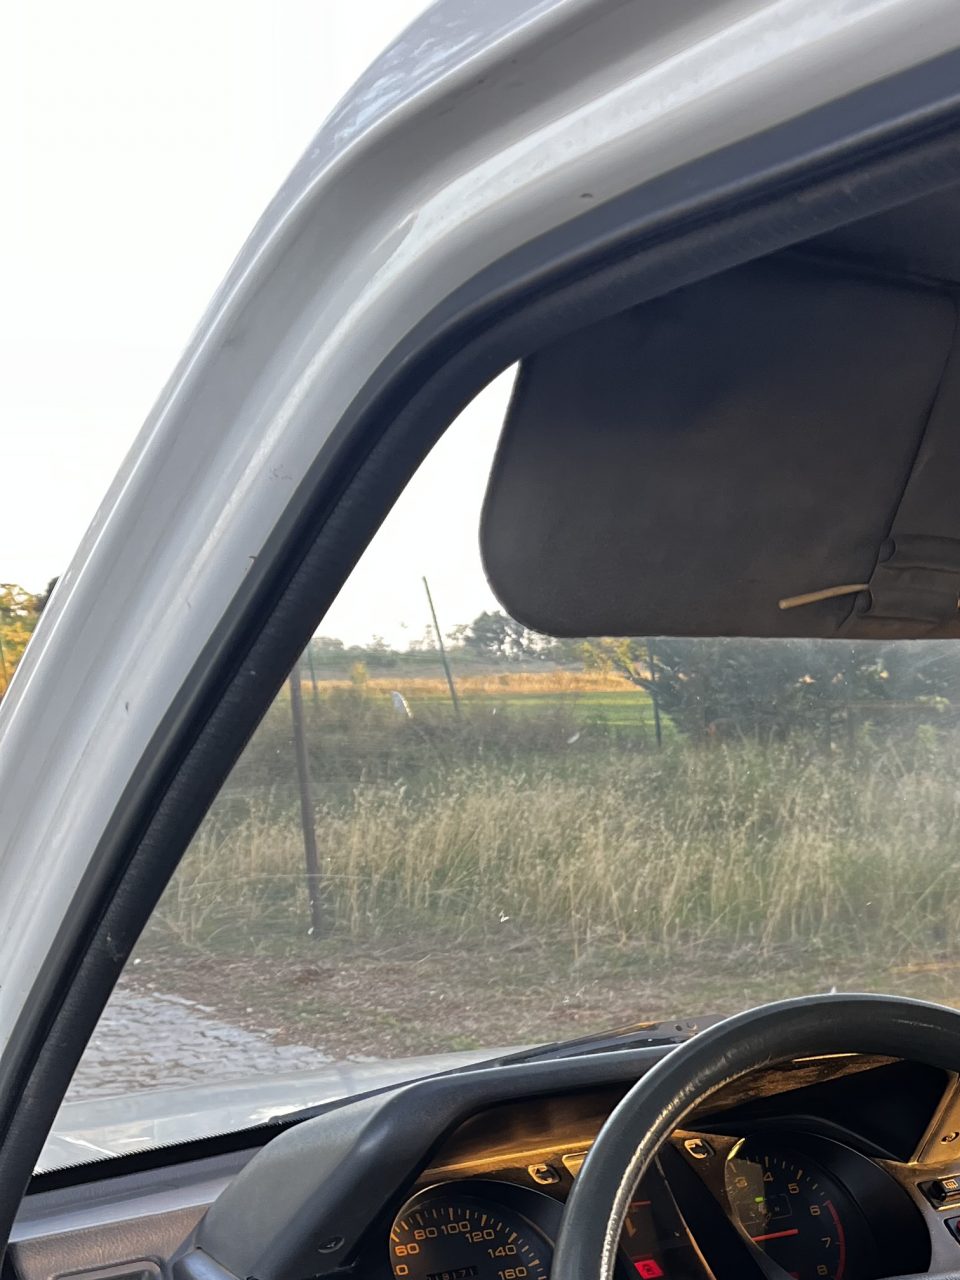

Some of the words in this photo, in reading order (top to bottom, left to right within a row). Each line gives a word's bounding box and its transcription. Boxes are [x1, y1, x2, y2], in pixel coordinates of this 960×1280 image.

[763, 1171, 774, 1182] 4
[788, 1182, 799, 1194] 5
[809, 1204, 821, 1216] 6
[414, 1227, 438, 1240] 80
[441, 1221, 470, 1235] 100
[465, 1229, 495, 1243] 120
[821, 1237, 831, 1248] 7
[394, 1243, 420, 1257] 60
[487, 1244, 517, 1258] 140
[498, 1266, 527, 1280] 160
[816, 1264, 828, 1276] 8
